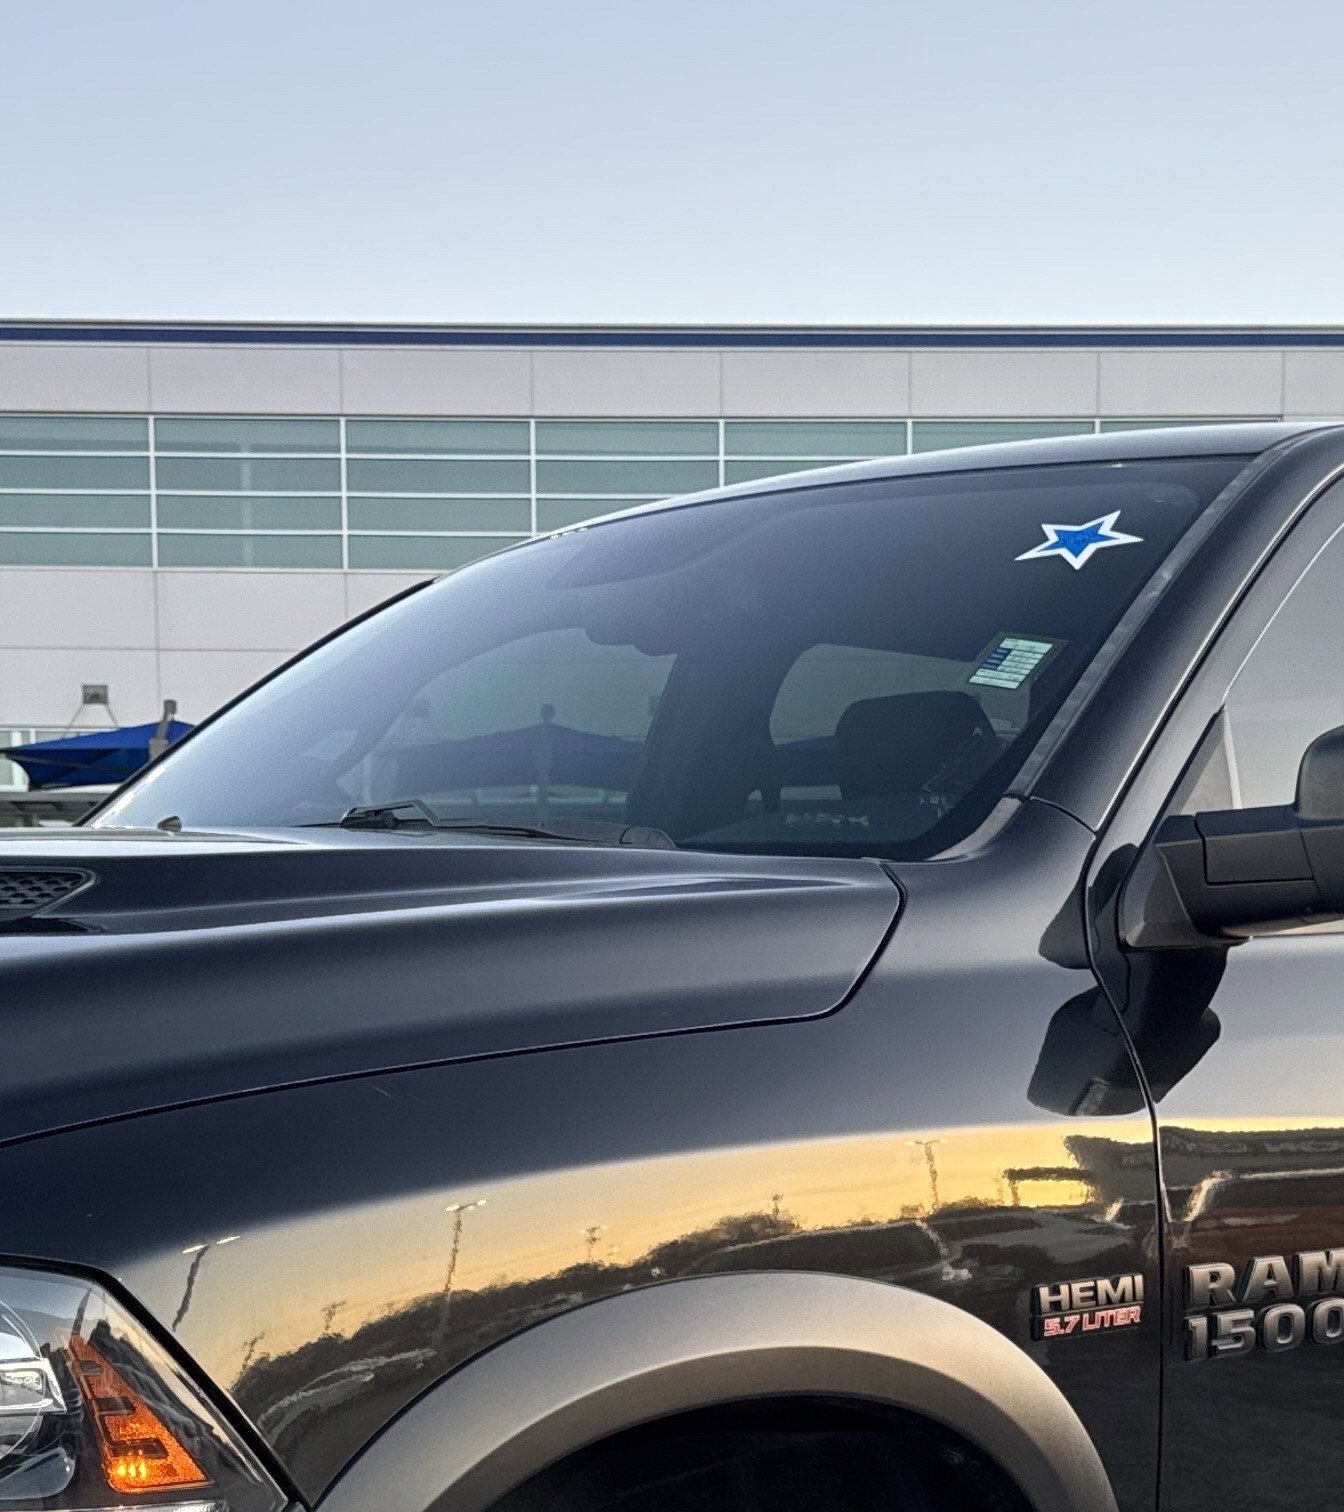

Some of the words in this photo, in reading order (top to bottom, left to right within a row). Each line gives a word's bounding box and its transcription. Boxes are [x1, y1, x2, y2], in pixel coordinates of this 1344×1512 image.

[1038, 1274, 1145, 1313] HEMI
[1043, 1313, 1082, 1338] 5.7
[1082, 1305, 1142, 1333] LITER
